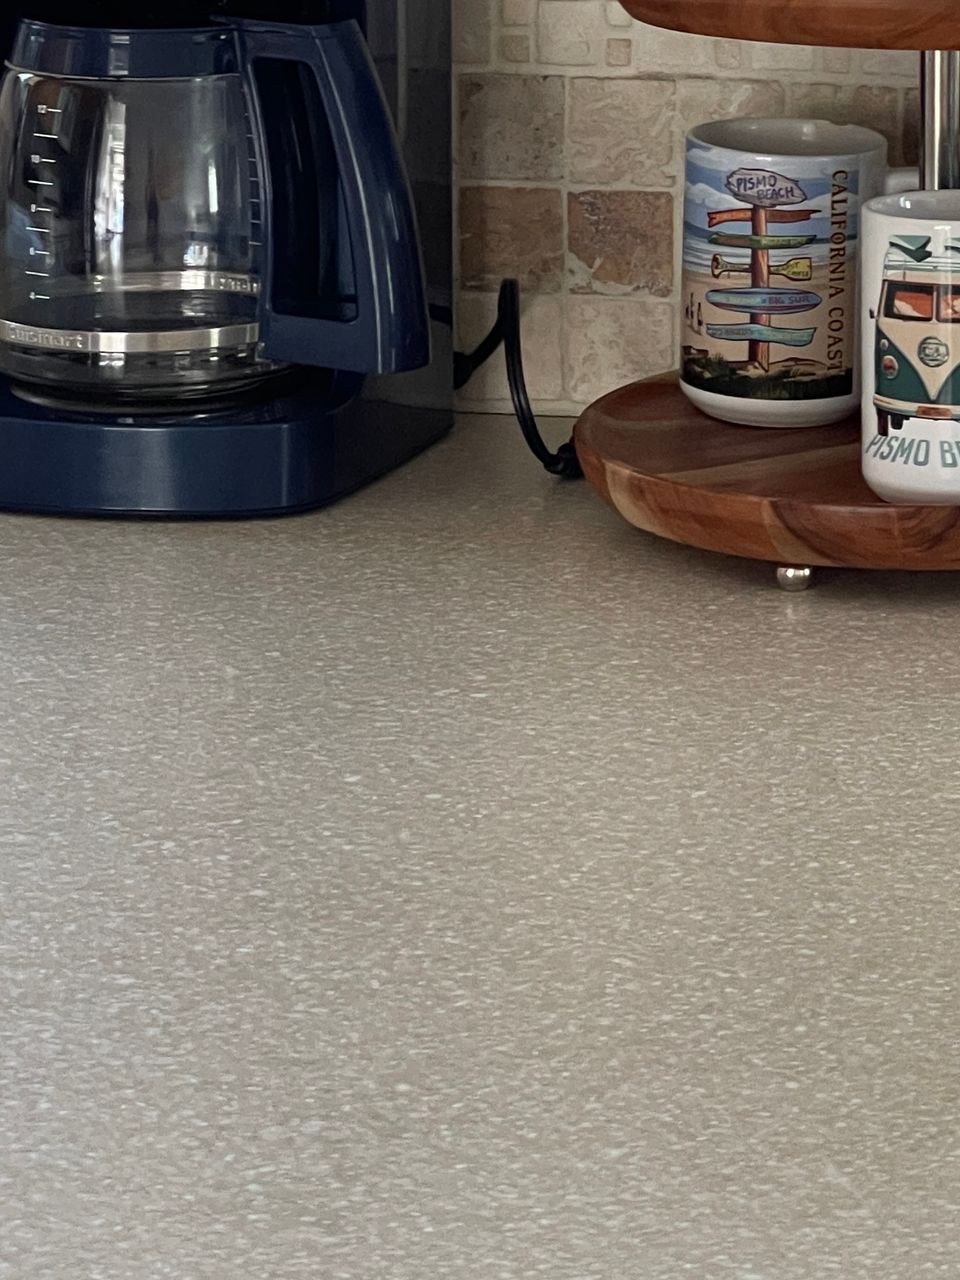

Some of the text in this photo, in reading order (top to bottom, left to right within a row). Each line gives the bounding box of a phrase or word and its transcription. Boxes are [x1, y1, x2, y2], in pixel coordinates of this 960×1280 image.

[735, 175, 778, 193] PISMO
[756, 186, 795, 201] BEACH
[827, 169, 848, 371] CALIFORNIA COAST
[865, 434, 930, 467] PISMO
